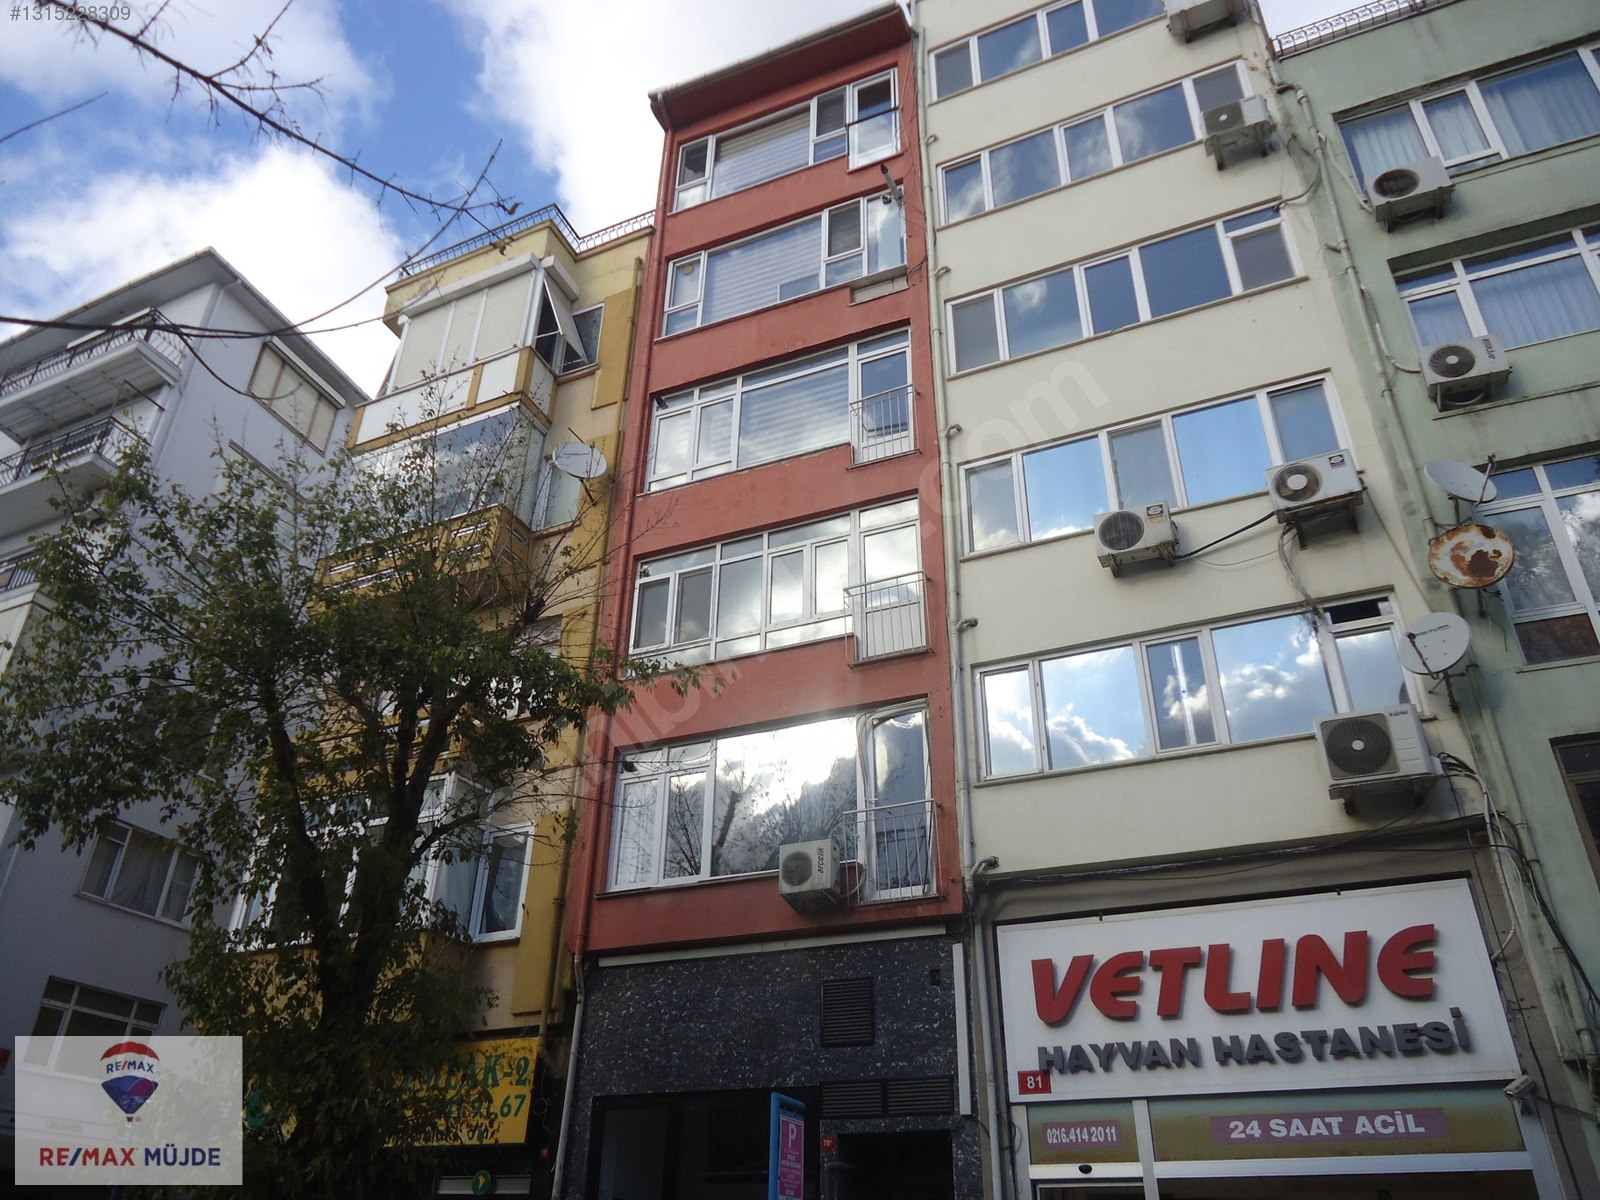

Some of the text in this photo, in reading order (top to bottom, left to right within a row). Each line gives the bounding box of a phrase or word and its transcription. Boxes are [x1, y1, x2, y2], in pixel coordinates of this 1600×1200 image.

[1031, 924, 1436, 1024] VETLINE
[1037, 1007, 1472, 1074] HAYVAN HASTANESİ
[1026, 1076, 1043, 1089] 81
[788, 1123, 797, 1149] P
[1229, 1111, 1426, 1139] 24 SAAT ACİL
